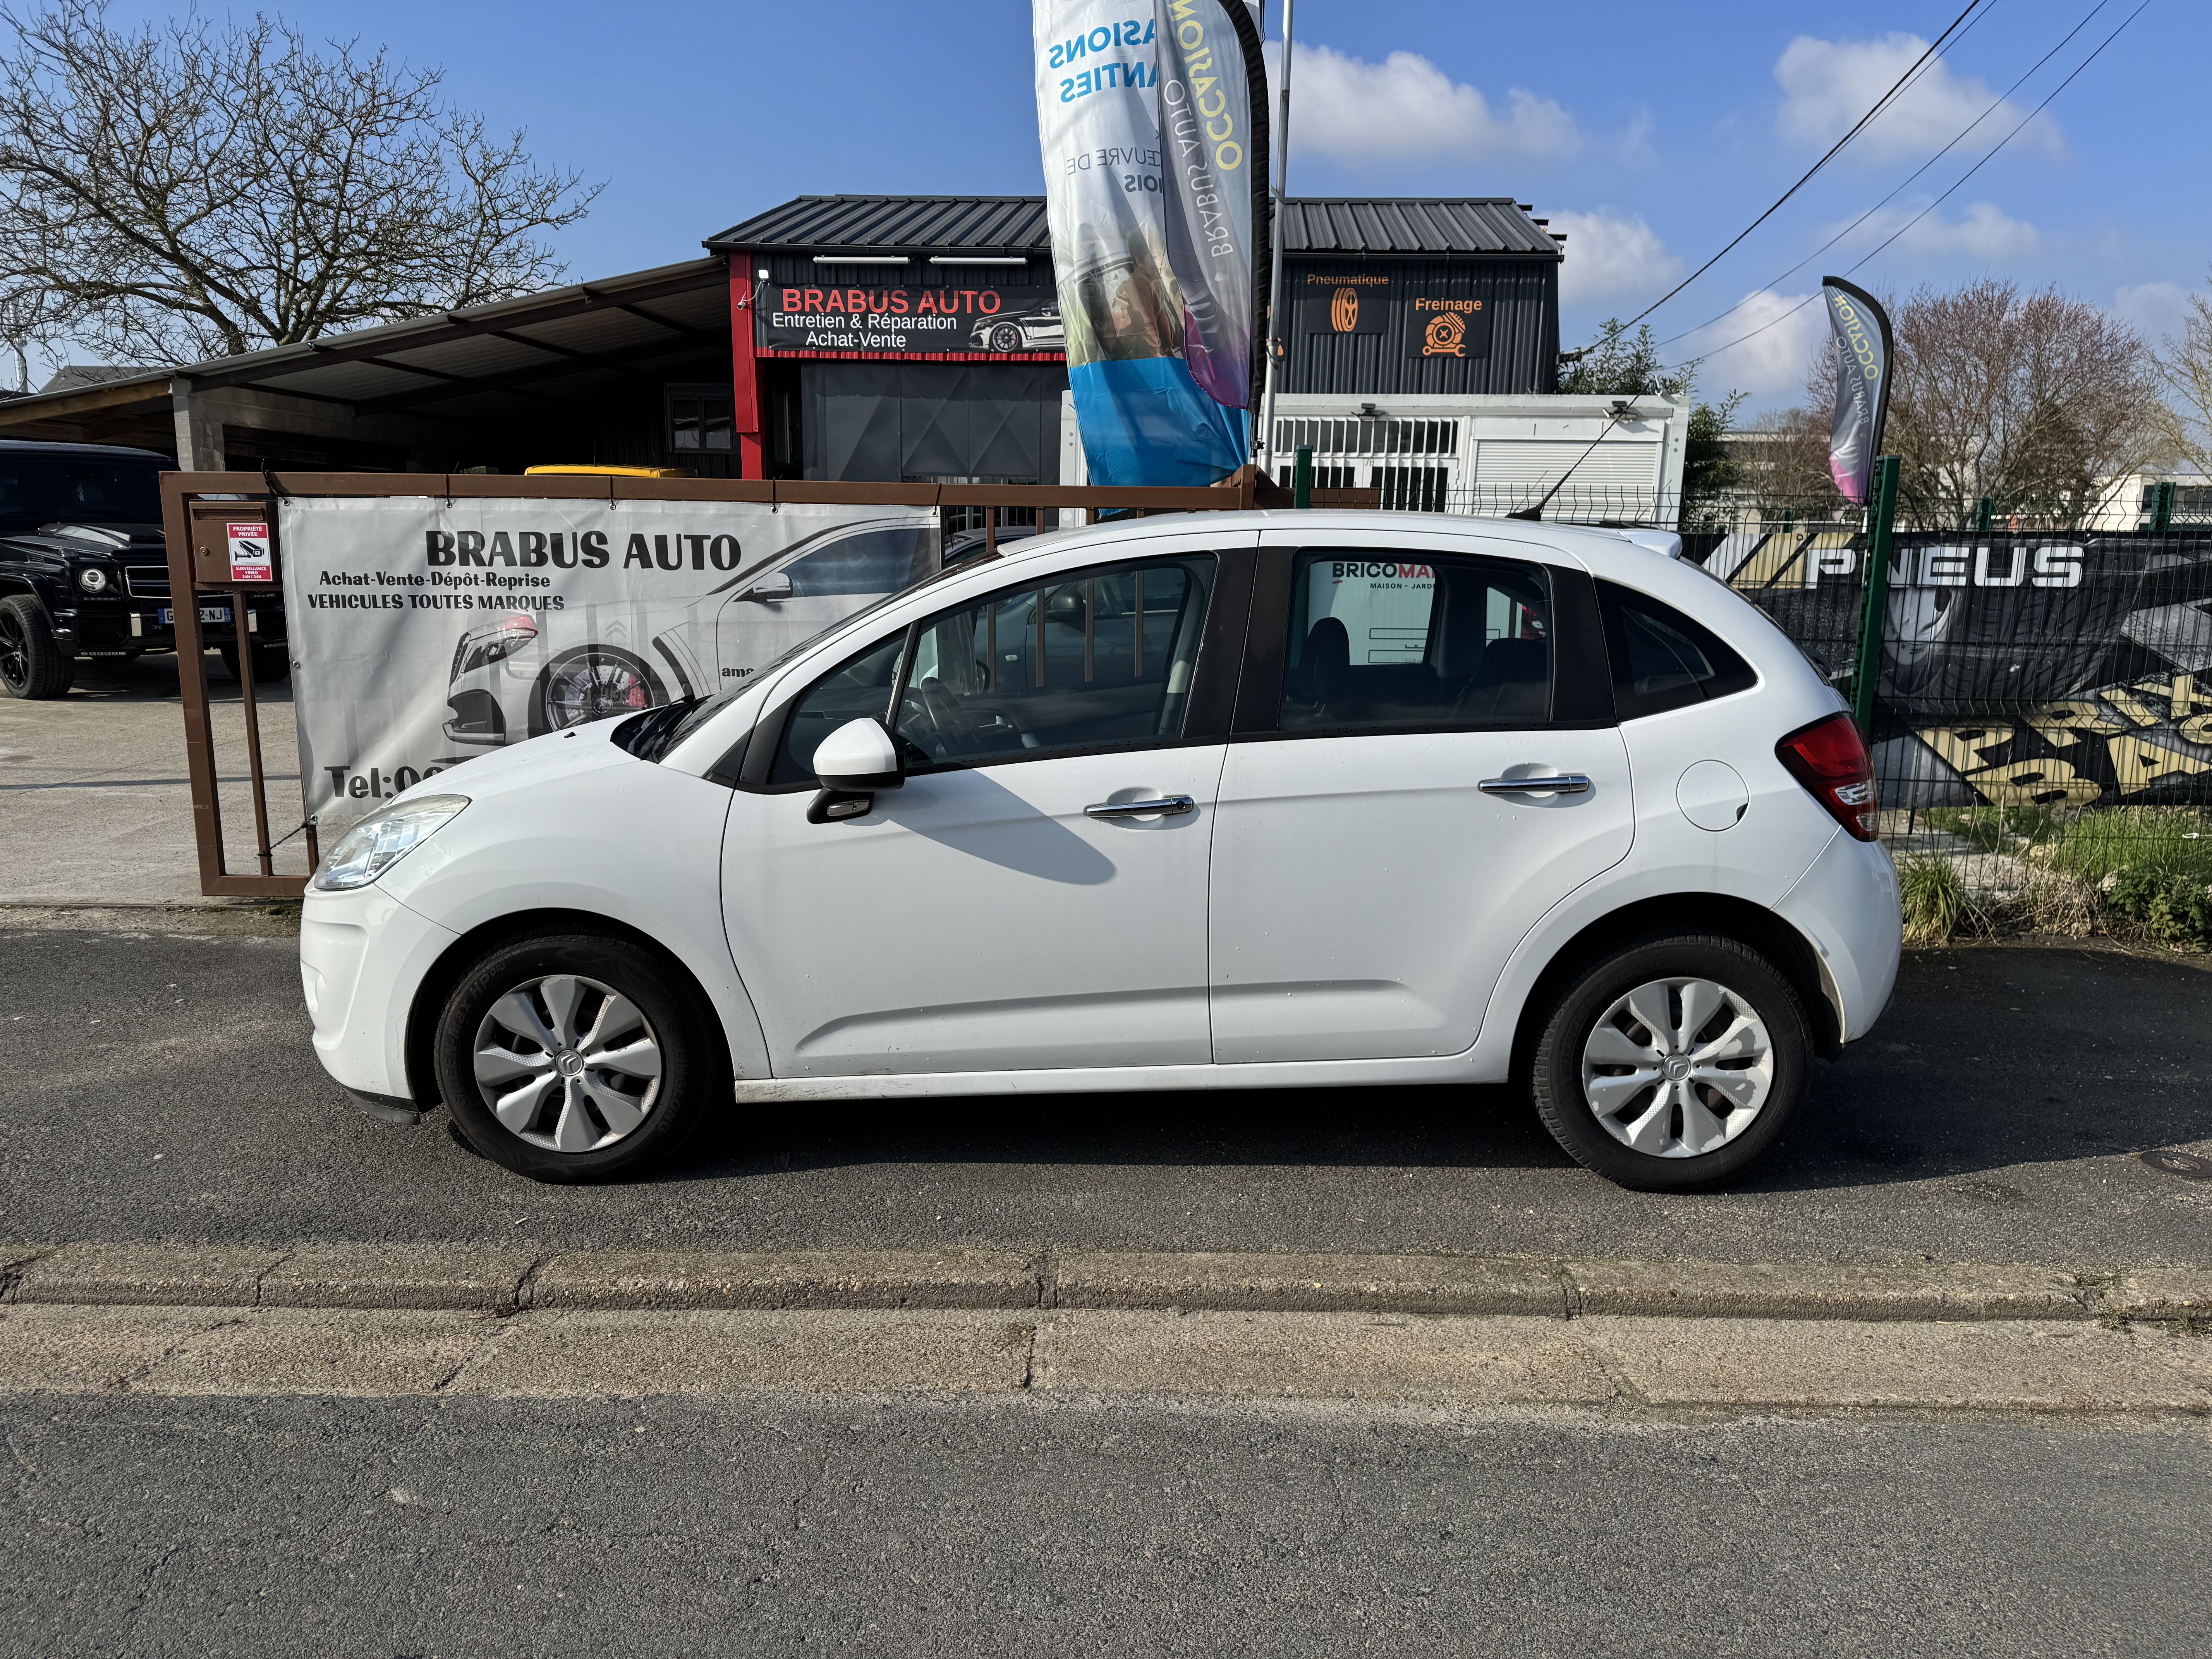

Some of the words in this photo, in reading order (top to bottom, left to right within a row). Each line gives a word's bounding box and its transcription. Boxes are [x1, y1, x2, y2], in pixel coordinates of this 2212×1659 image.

[1307, 273, 1389, 287] Pneumatique
[783, 289, 909, 313] BRABUS
[918, 290, 1001, 314] AUTO
[1415, 298, 1482, 314] Freinage
[773, 313, 845, 328] Entretien
[850, 314, 863, 328] &
[868, 313, 957, 332] Réparation
[805, 332, 906, 347] Achat-Vente
[426, 530, 610, 568] BRABUS
[623, 533, 742, 571] AUTO
[319, 571, 550, 591] Achat-Vente-Dépôt-Reprise
[307, 594, 404, 609] VEHICULES
[407, 594, 473, 609] TOUTES
[478, 595, 565, 611] MARQUES
[469, 973, 490, 999] HP
